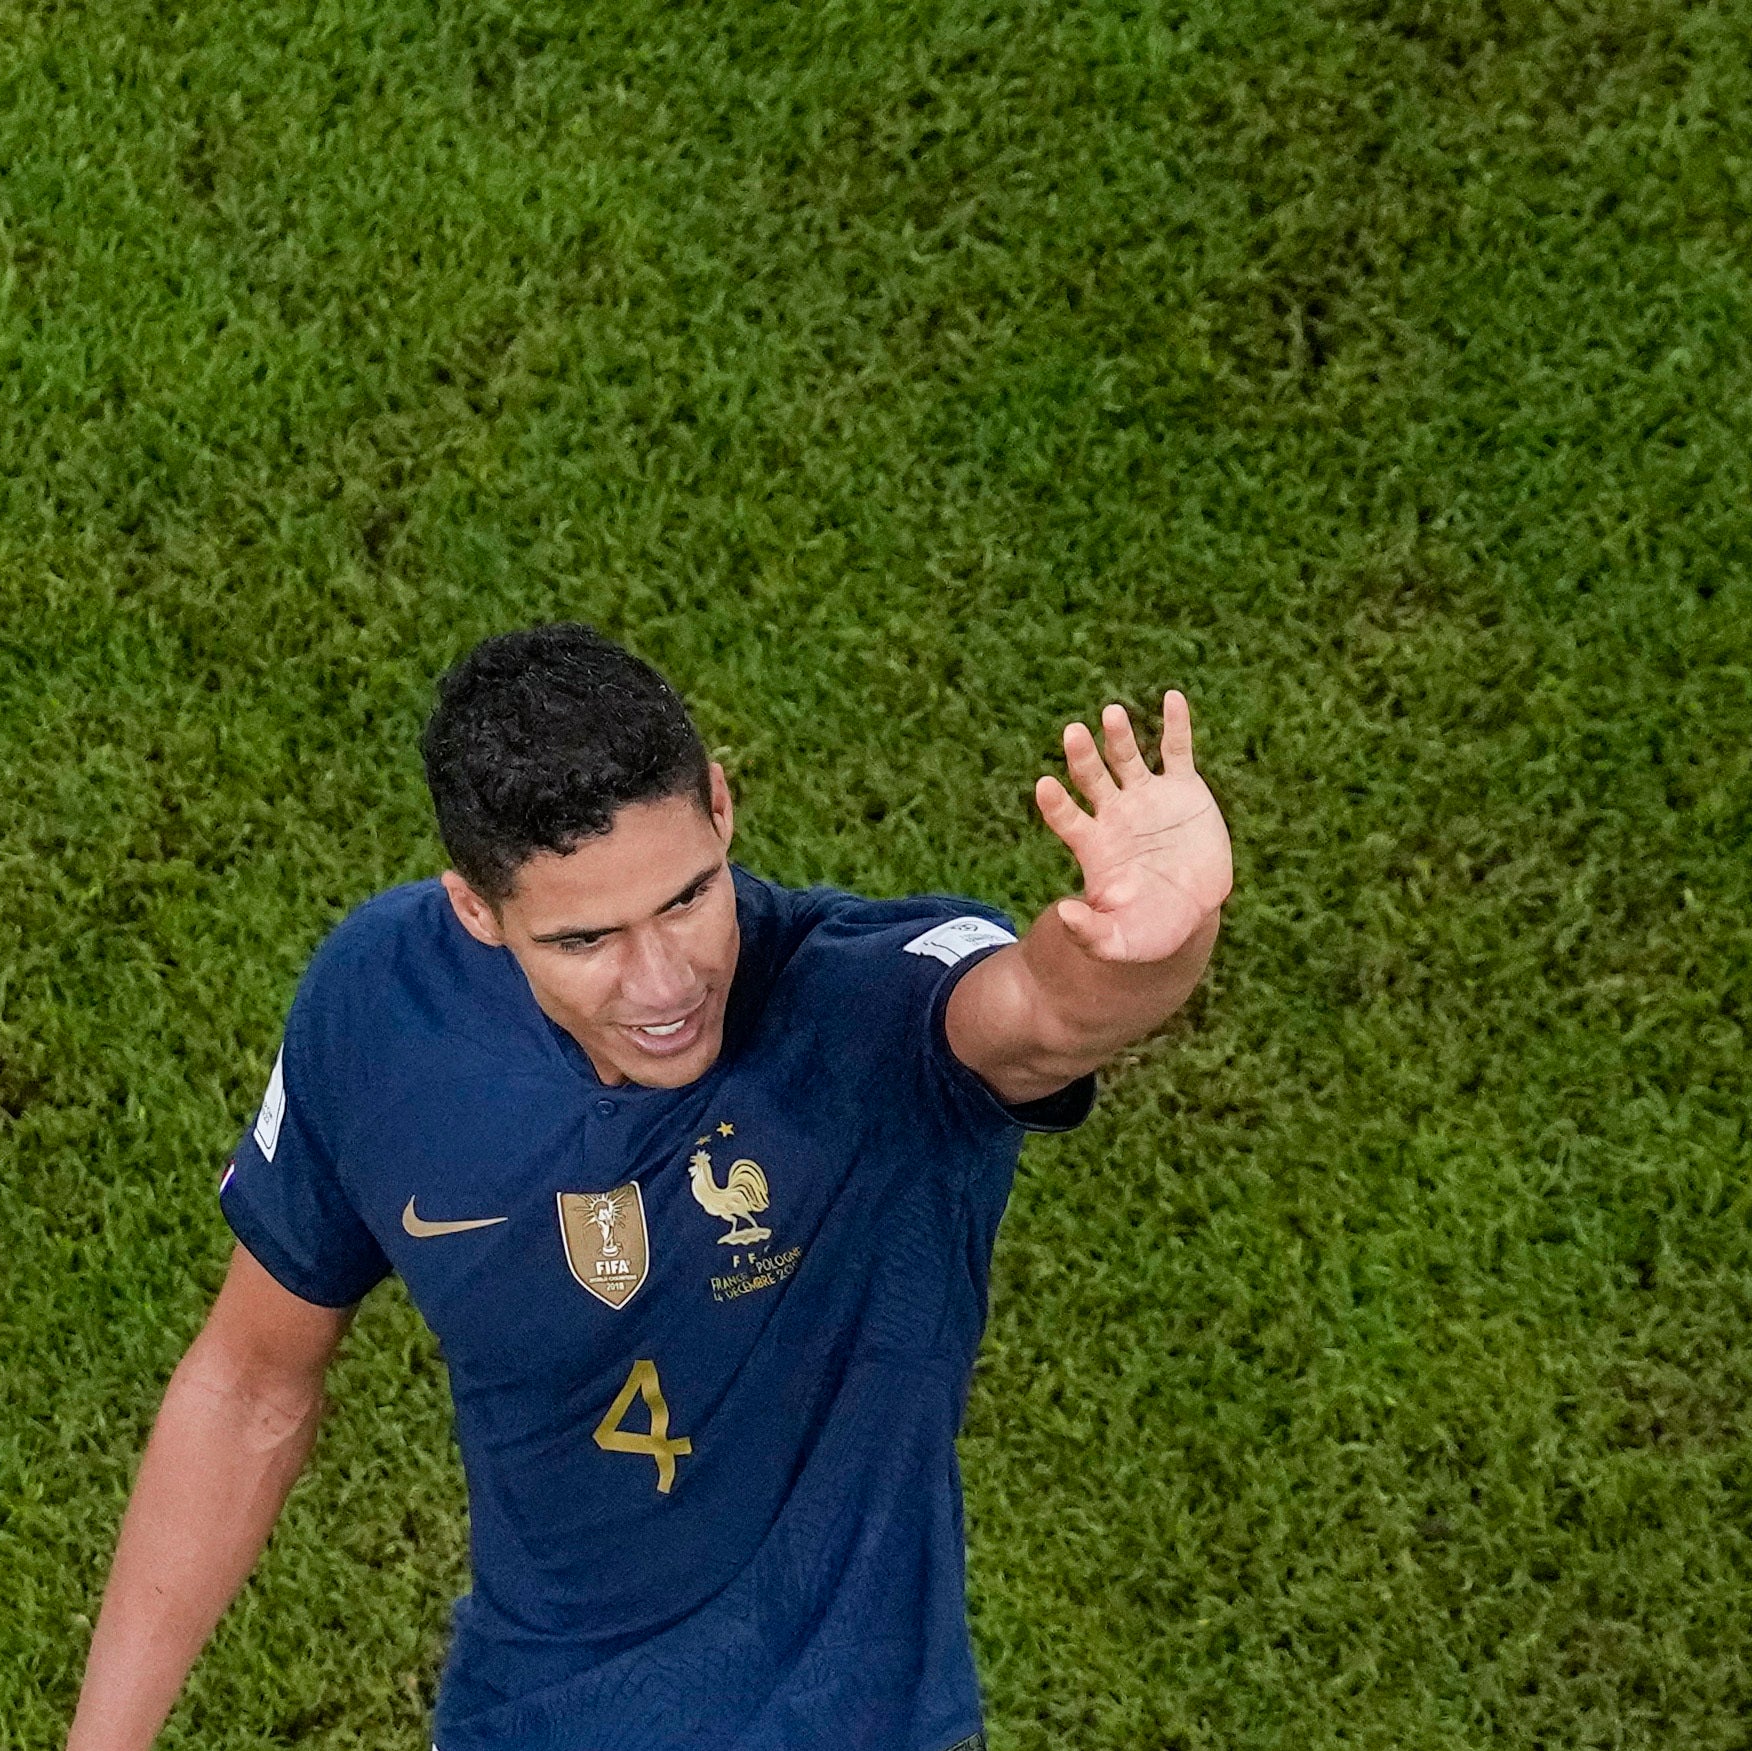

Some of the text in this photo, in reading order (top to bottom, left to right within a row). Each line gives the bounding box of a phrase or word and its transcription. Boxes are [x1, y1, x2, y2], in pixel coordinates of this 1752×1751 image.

[595, 1259, 630, 1275] FIFA
[776, 1260, 798, 1280] 20
[592, 1359, 692, 1493] 4
